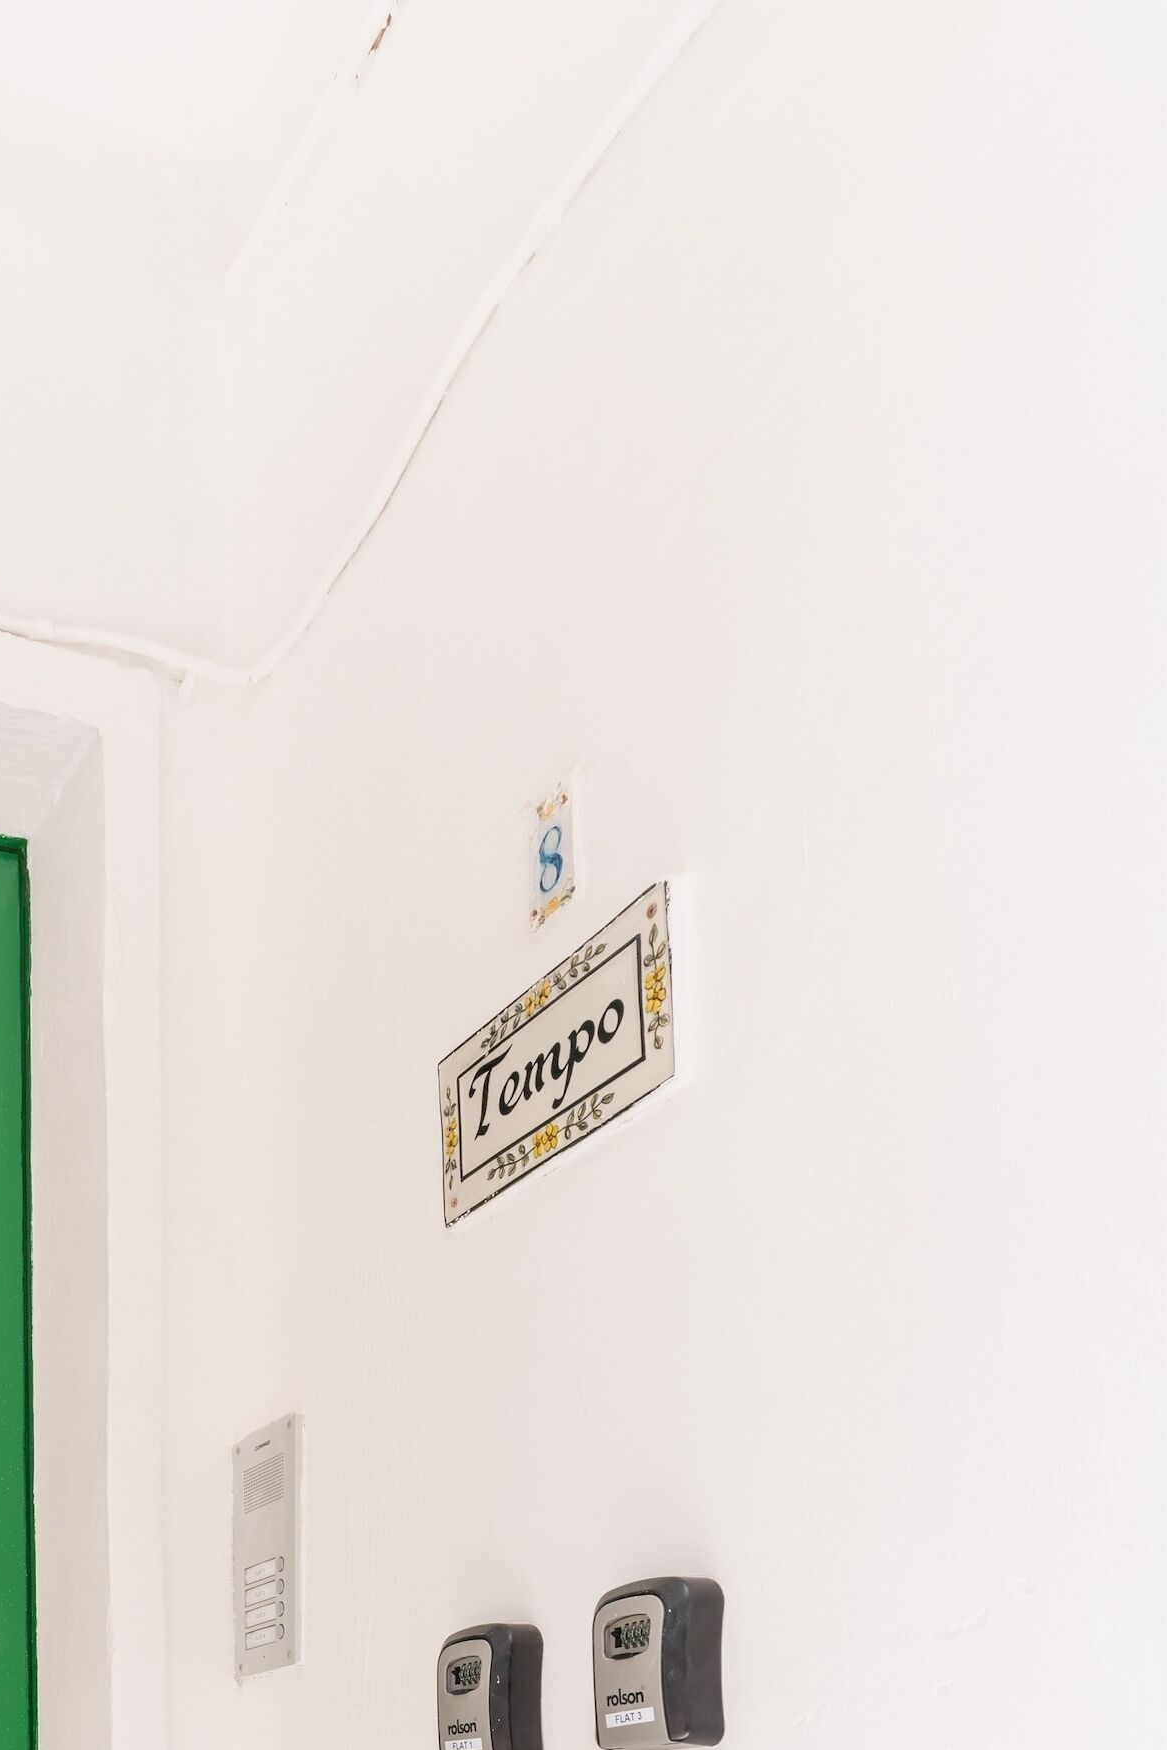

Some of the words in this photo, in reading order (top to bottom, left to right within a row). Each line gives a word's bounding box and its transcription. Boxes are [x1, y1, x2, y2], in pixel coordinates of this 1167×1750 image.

[538, 825, 563, 893] 8
[468, 998, 624, 1141] Tempo
[606, 1688, 644, 1707] rolson
[614, 1712, 635, 1724] FLAT
[637, 1711, 643, 1720] 3
[448, 1719, 477, 1735] rolson
[452, 1741, 467, 1750] FLAT
